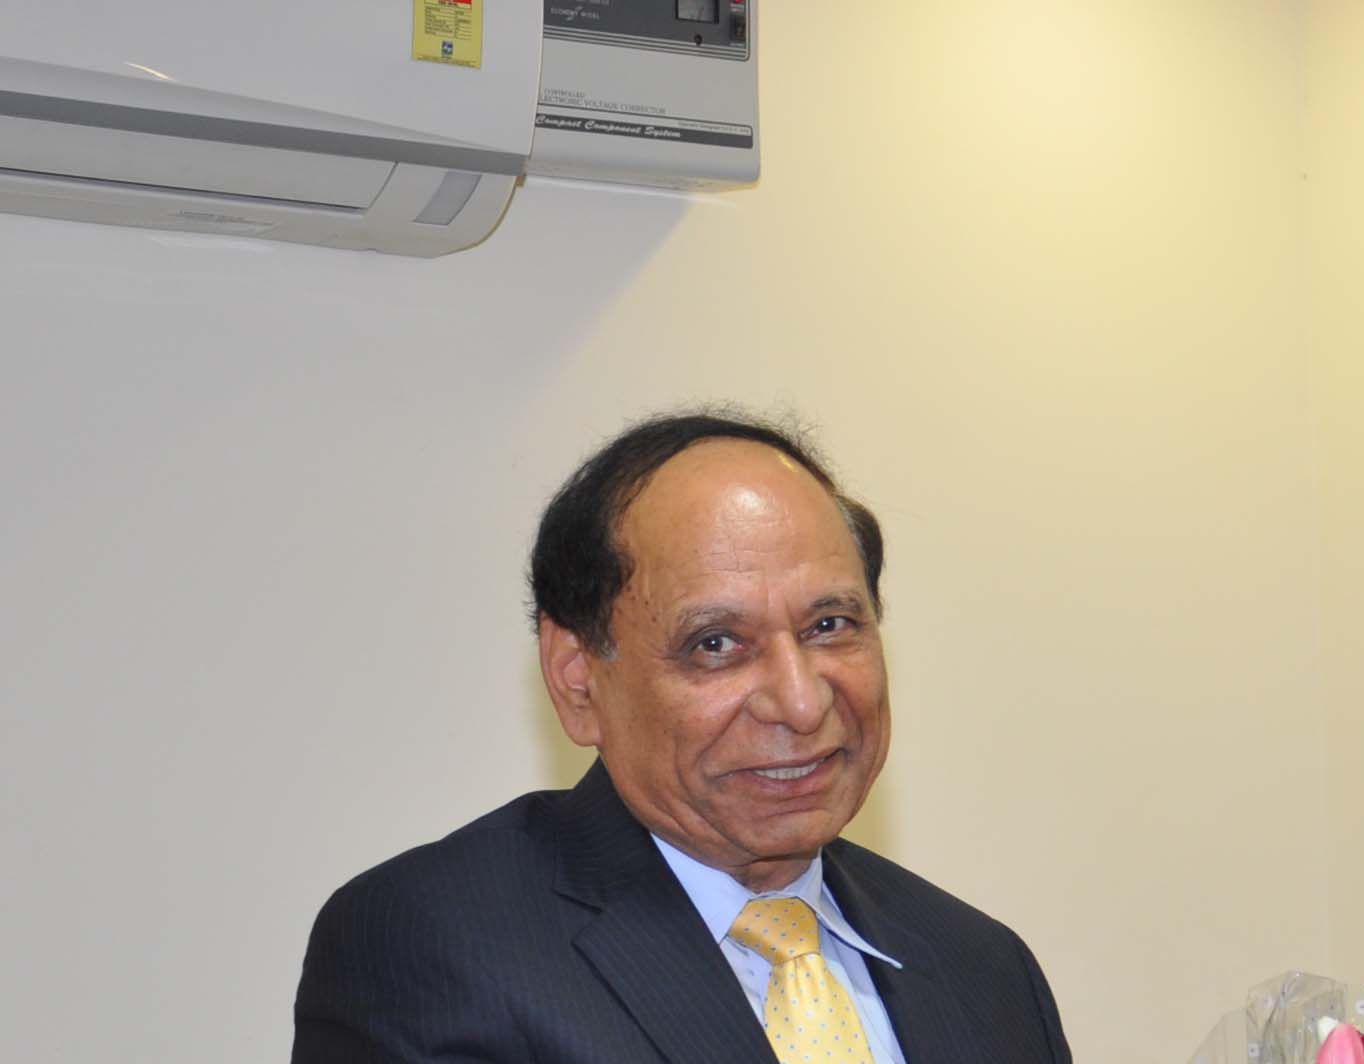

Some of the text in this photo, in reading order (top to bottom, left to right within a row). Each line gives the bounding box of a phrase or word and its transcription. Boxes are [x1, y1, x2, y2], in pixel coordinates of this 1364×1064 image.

[535, 115, 583, 128] Compact
[584, 120, 642, 134] Component
[643, 126, 681, 139] System
